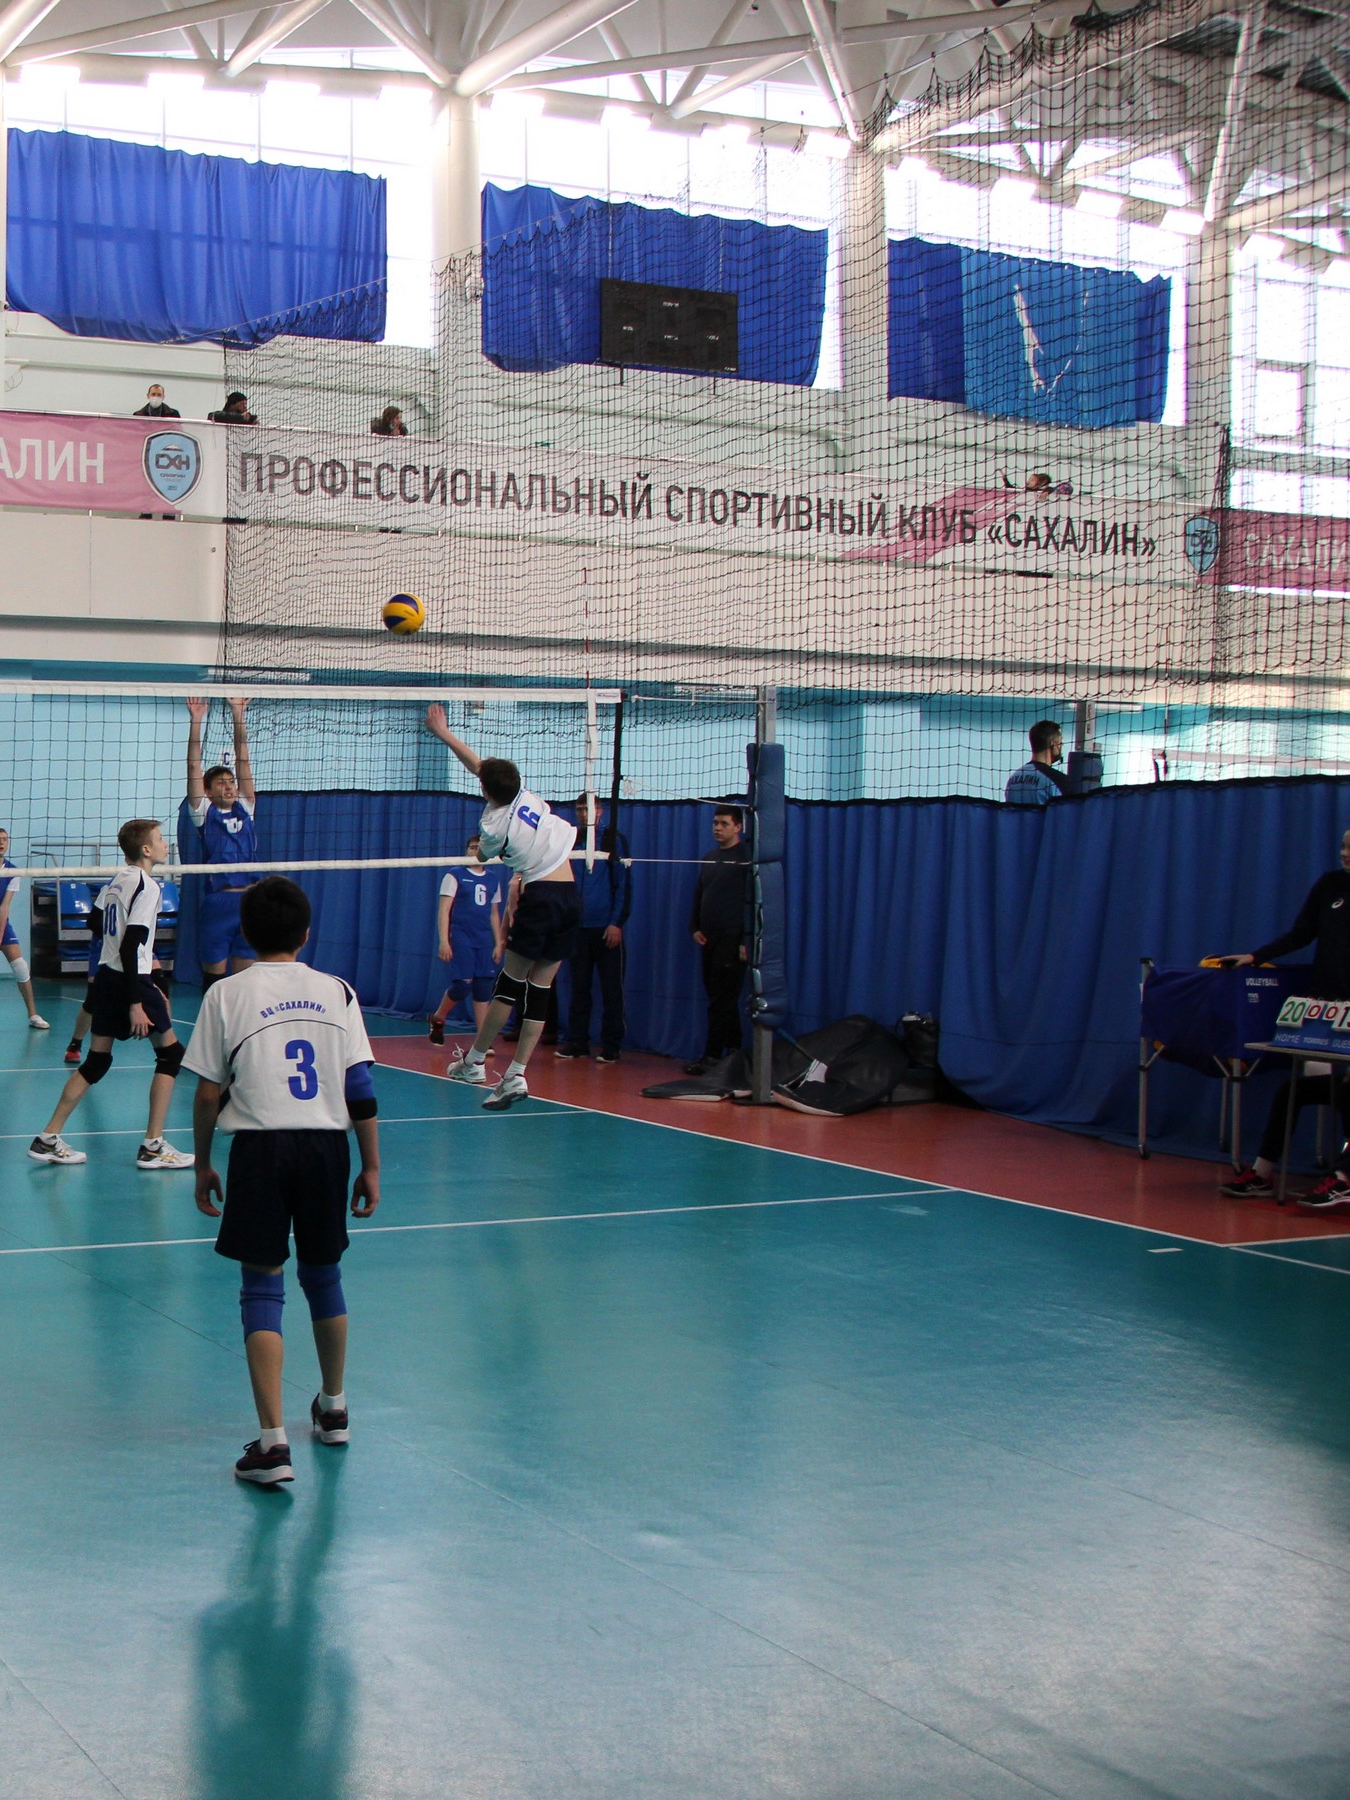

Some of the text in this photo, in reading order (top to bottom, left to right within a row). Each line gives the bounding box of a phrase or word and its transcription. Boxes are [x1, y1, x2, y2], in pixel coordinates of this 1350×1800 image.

[238, 452, 1156, 557] ПРОФЕССИОНАЛЬНЫЙ СПОРТИВНЫЙ КЛУБ «САХАЛИН»
[474, 883, 487, 906] 6
[103, 902, 118, 937] 10
[1245, 978, 1279, 987] VOLLEYBALL
[259, 1006, 275, 1019] ВЦ
[1279, 1001, 1307, 1023] 20
[1337, 1006, 1350, 1028] 1
[1274, 1033, 1301, 1044] HOME
[284, 1039, 319, 1101] 3
